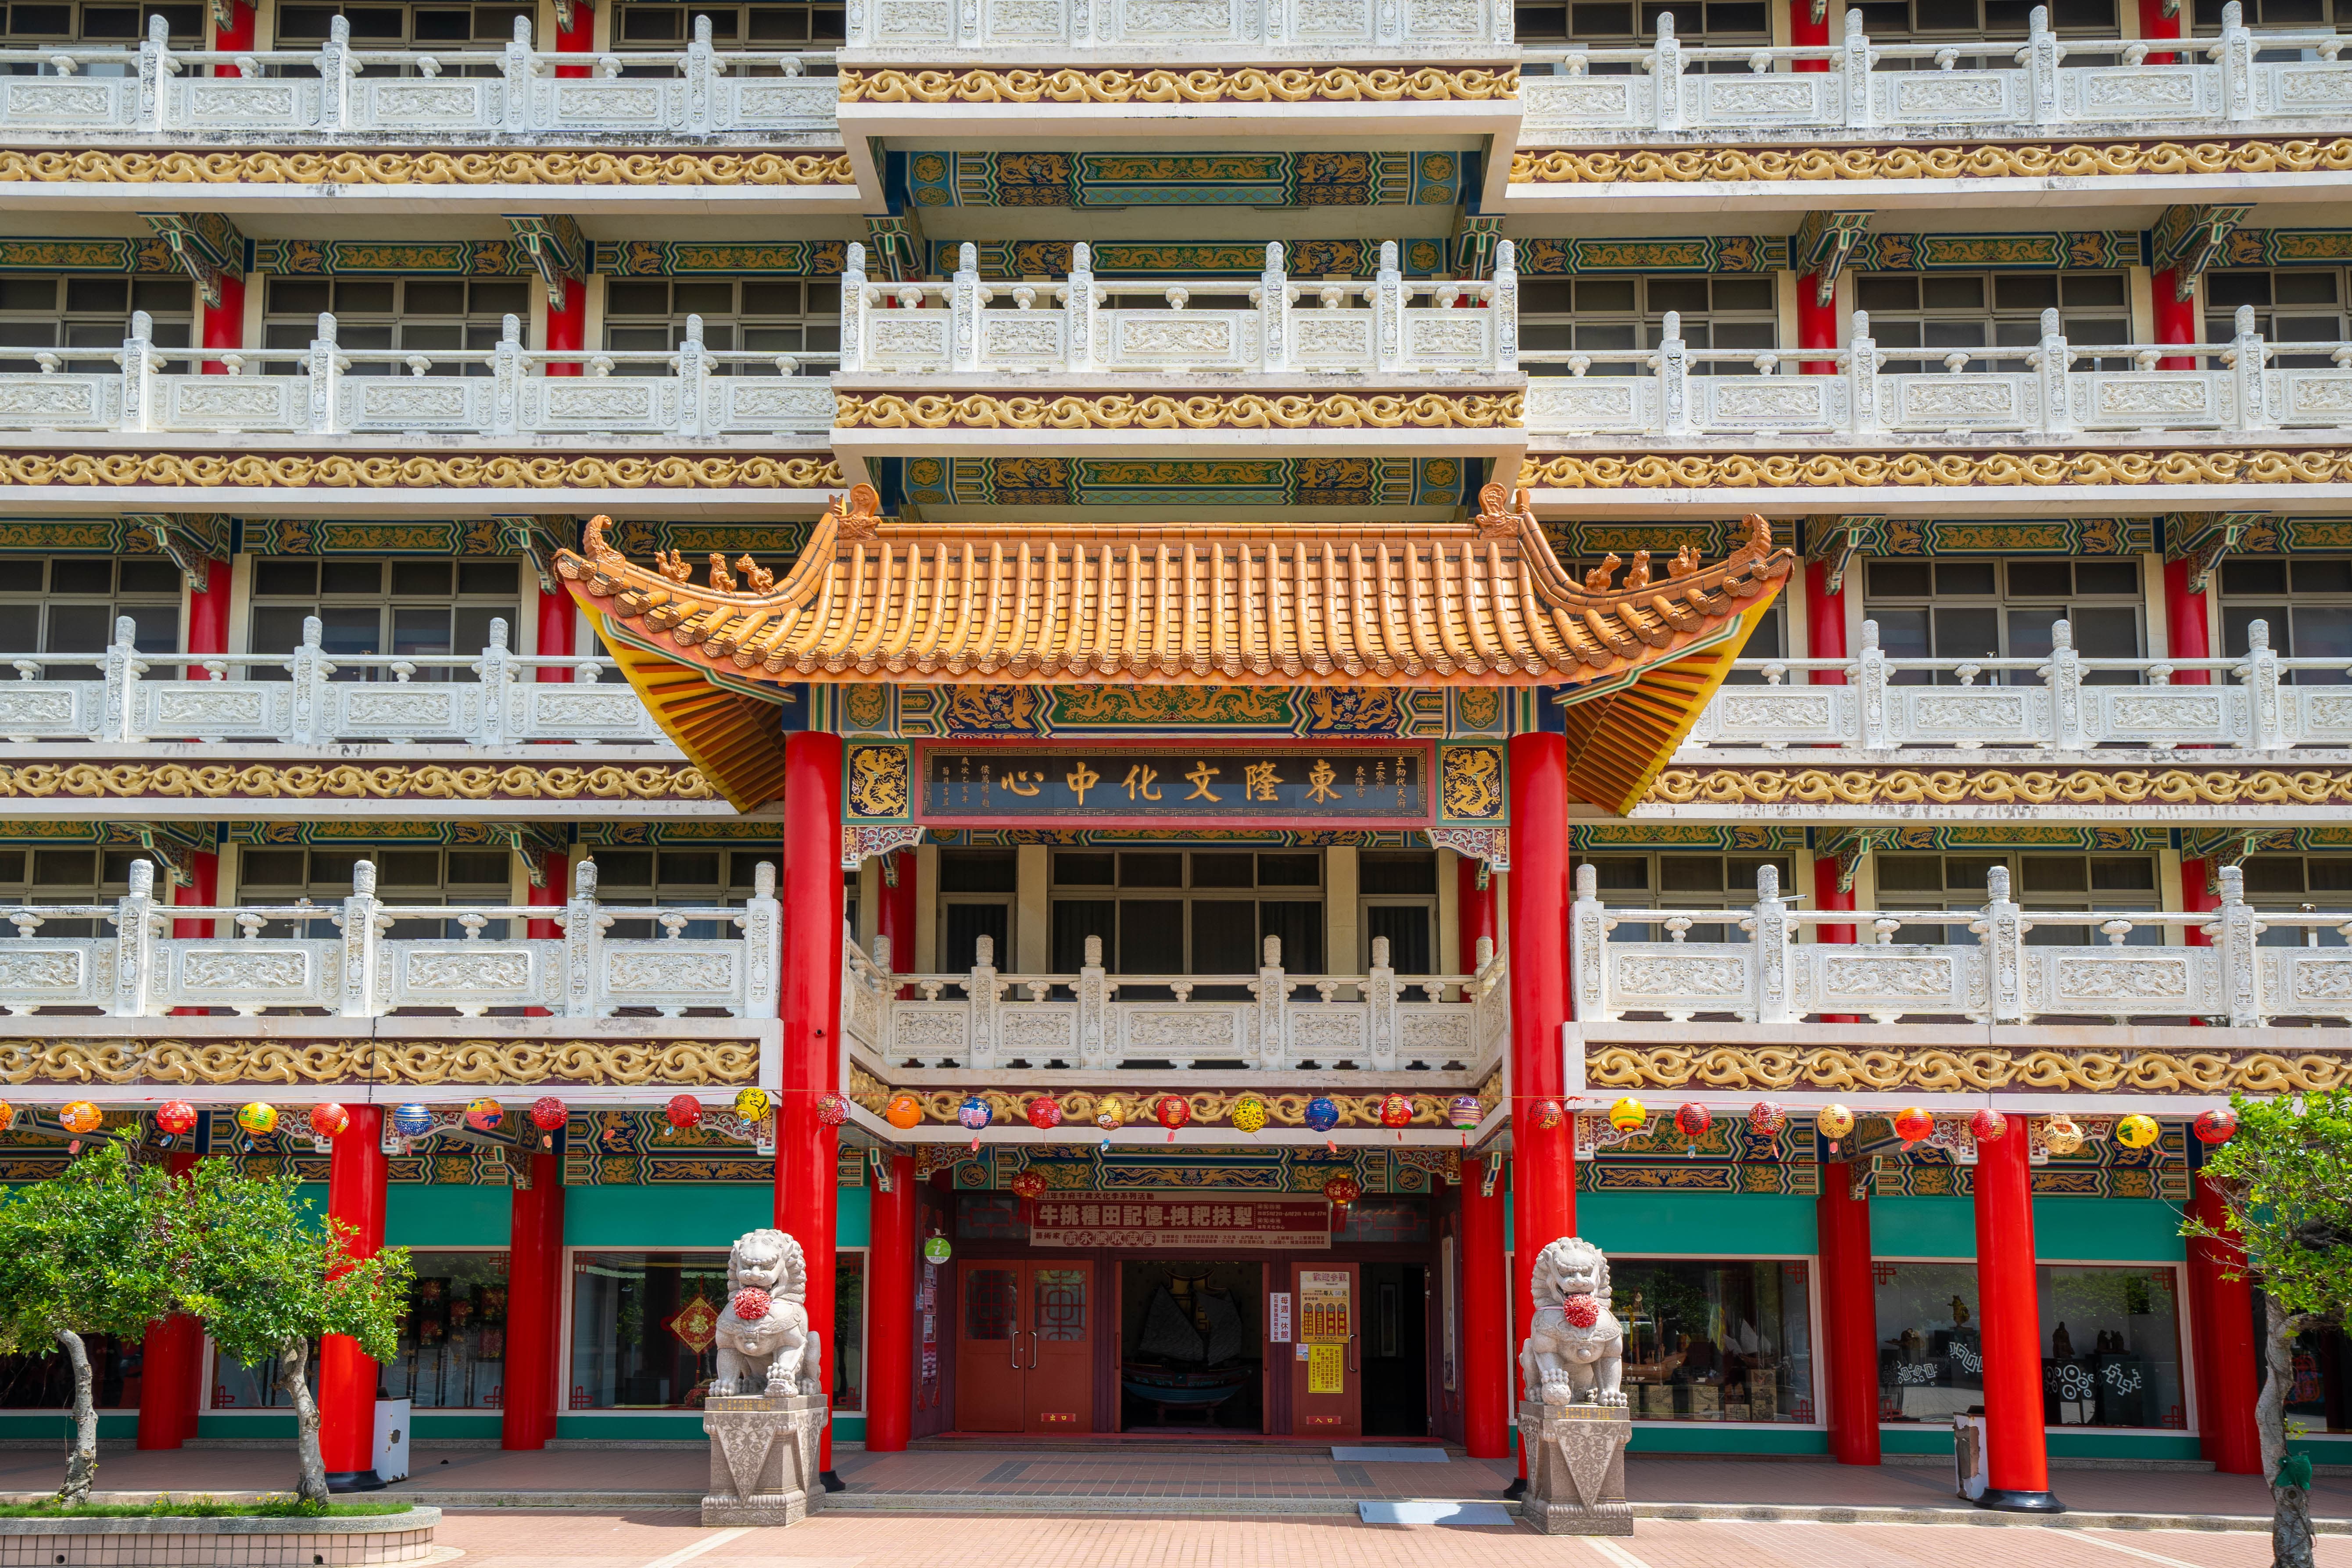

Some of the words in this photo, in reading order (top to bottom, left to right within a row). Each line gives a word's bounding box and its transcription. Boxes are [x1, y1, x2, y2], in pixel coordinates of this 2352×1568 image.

[1001, 759, 1343, 806] 東隆文化中心
[1355, 766, 1366, 798] 東隆宮
[1038, 1192, 1155, 1200] 11年李府千歲文化季系列活動
[1313, 1273, 1347, 1282] 歡迎參觀
